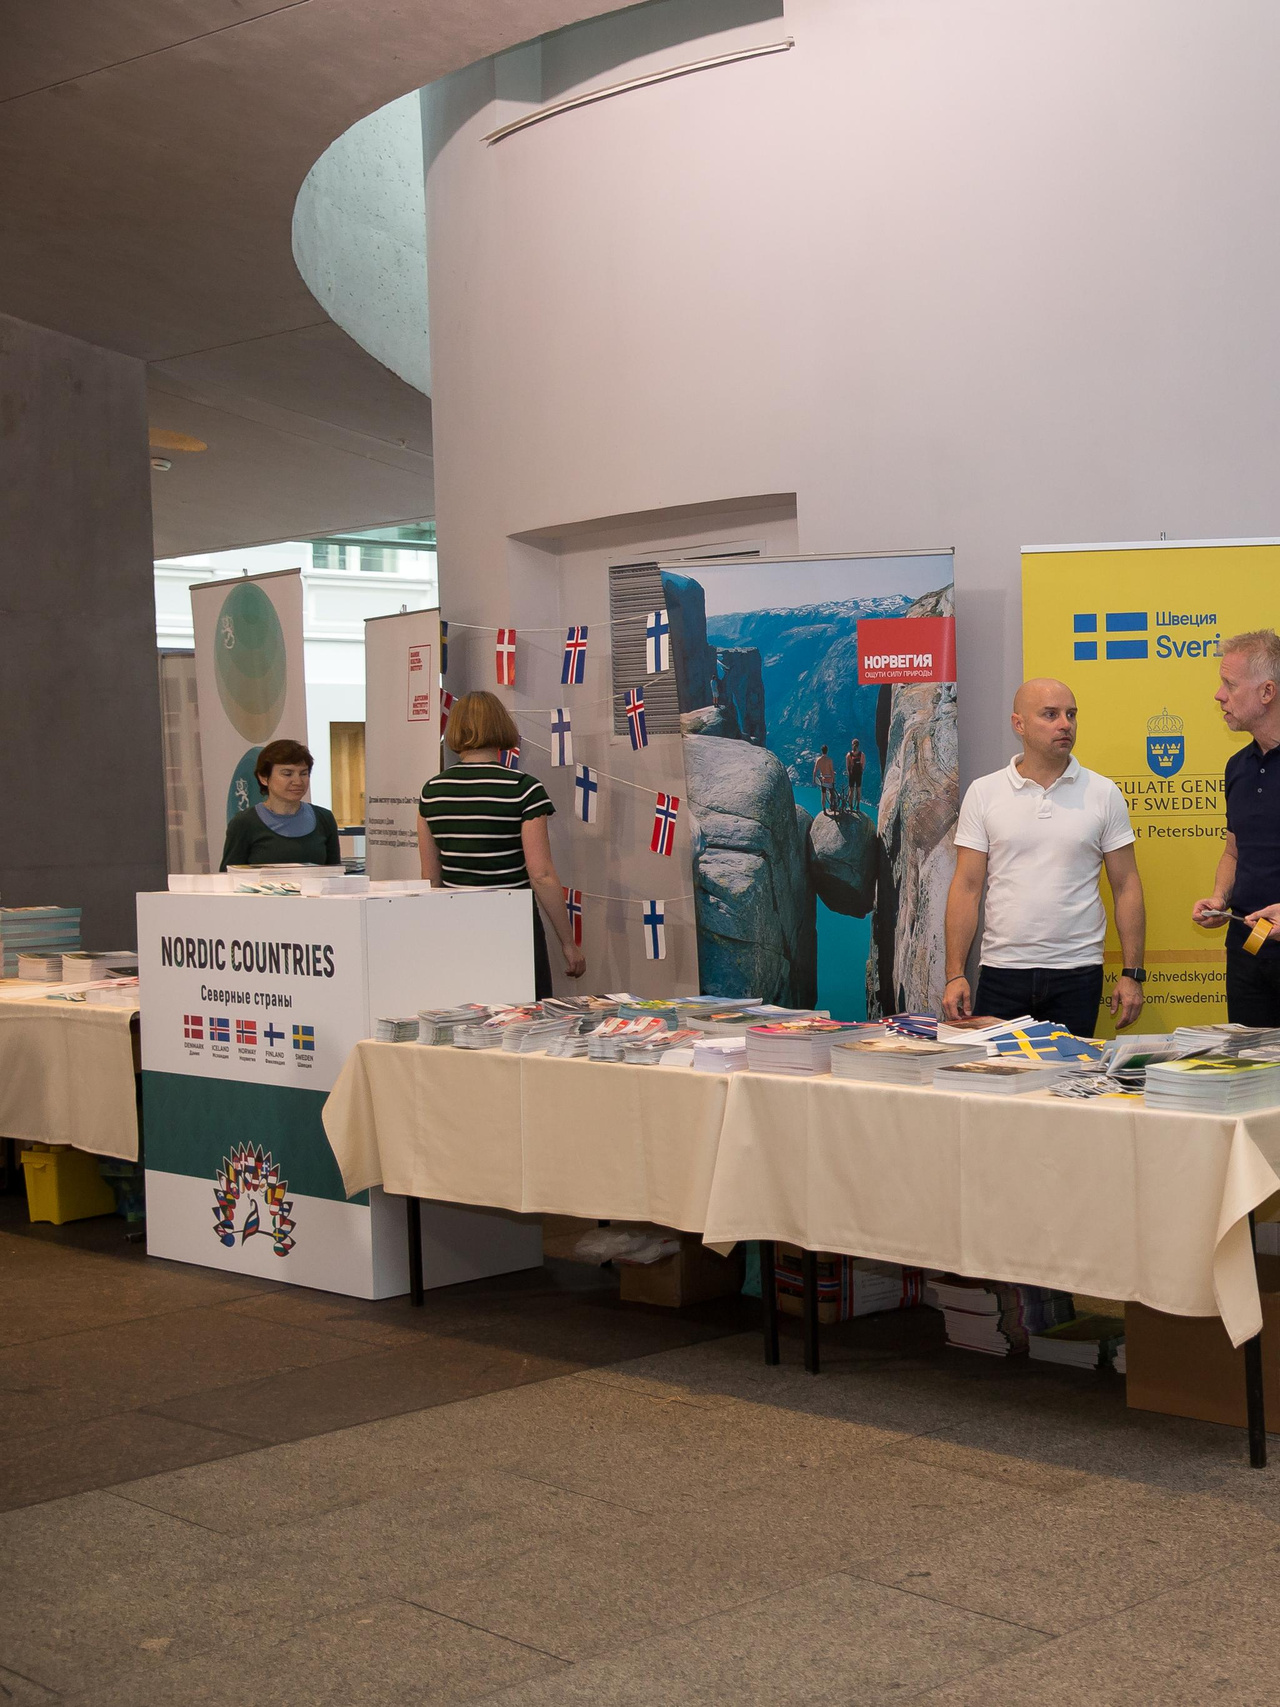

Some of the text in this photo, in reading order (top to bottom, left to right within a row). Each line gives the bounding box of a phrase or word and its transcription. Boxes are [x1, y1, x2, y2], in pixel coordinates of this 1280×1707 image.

[1155, 611, 1217, 628] Швеция
[864, 653, 933, 669] НОРВЕГИЯ
[864, 671, 887, 679] ОЩУТИ
[886, 670, 903, 678] СИЛУ
[1144, 796, 1217, 811] SWEDEN
[161, 936, 335, 978] NORDIC COUNTRIES
[200, 984, 293, 1010] Северные страны
[184, 1041, 204, 1050] DENMARK
[211, 1044, 230, 1053] ICELAND
[238, 1047, 256, 1056] NORWAY
[265, 1050, 285, 1059] FINLAND
[295, 1053, 314, 1062] SWEDEN
